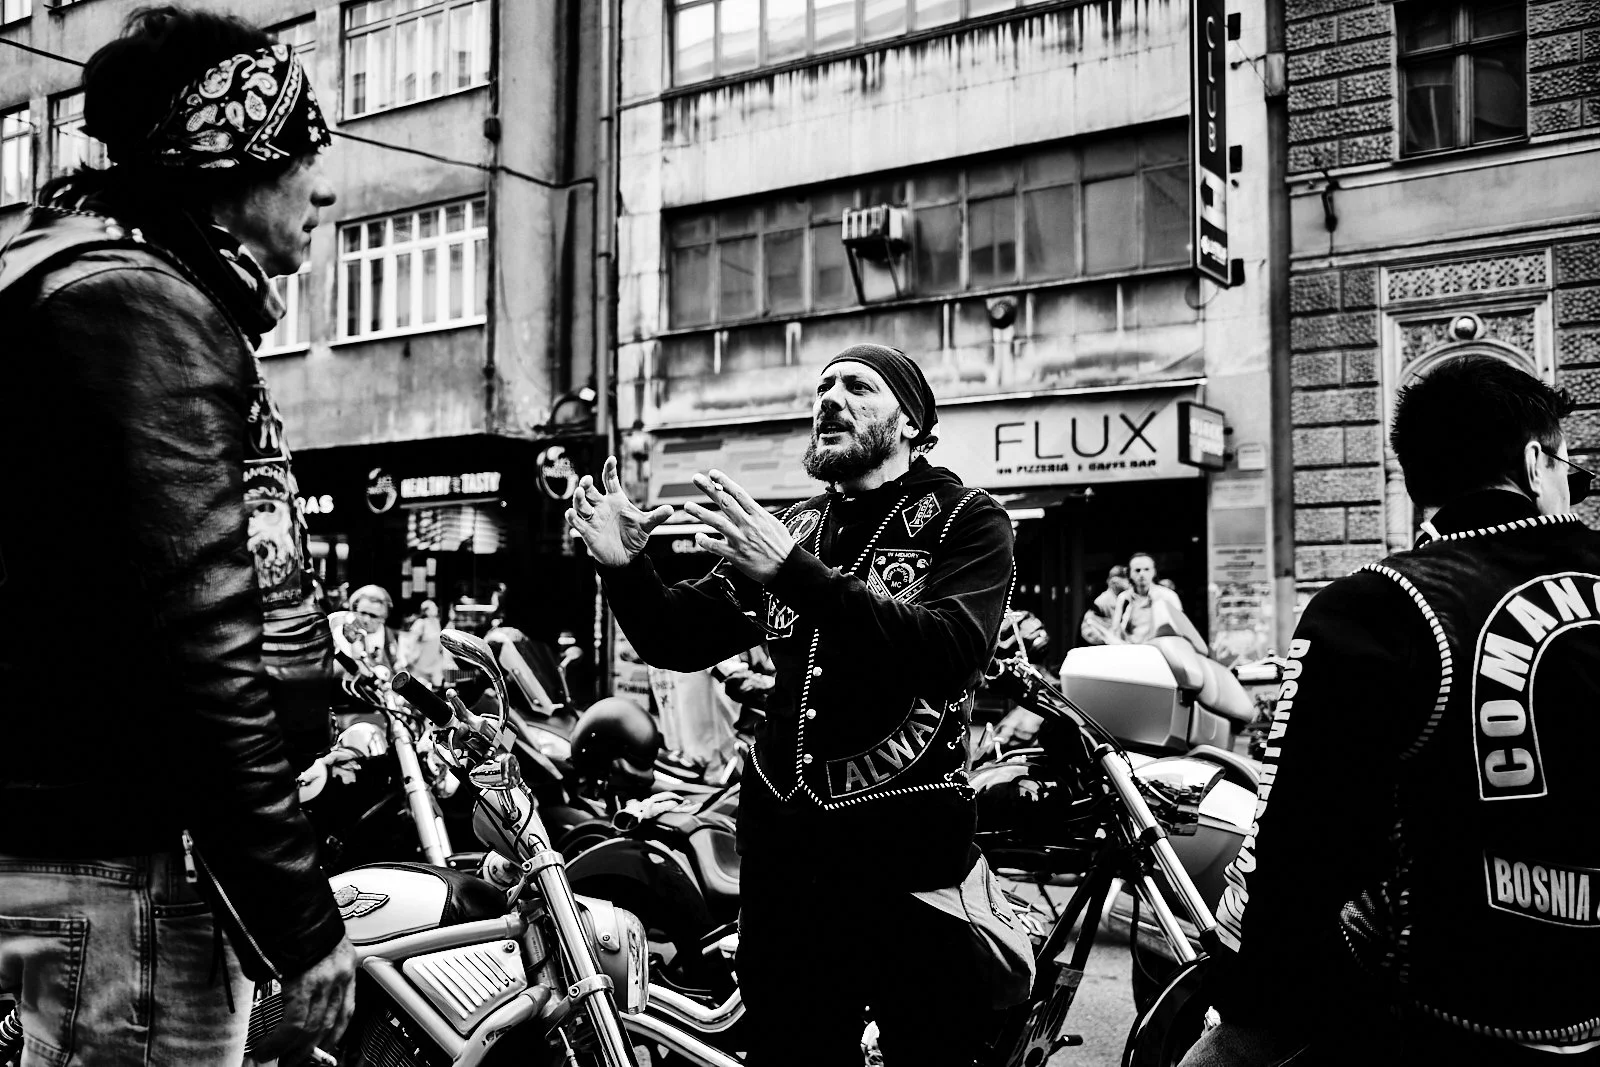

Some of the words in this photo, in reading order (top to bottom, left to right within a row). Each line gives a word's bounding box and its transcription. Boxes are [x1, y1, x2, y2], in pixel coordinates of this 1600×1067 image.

[1206, 16, 1217, 153] CLUB
[995, 411, 1156, 461] FLUX
[891, 580, 903, 588] MC
[1479, 576, 1600, 788] COMAN
[845, 697, 942, 793] ALWAY
[1493, 856, 1590, 922] BOSNIA
